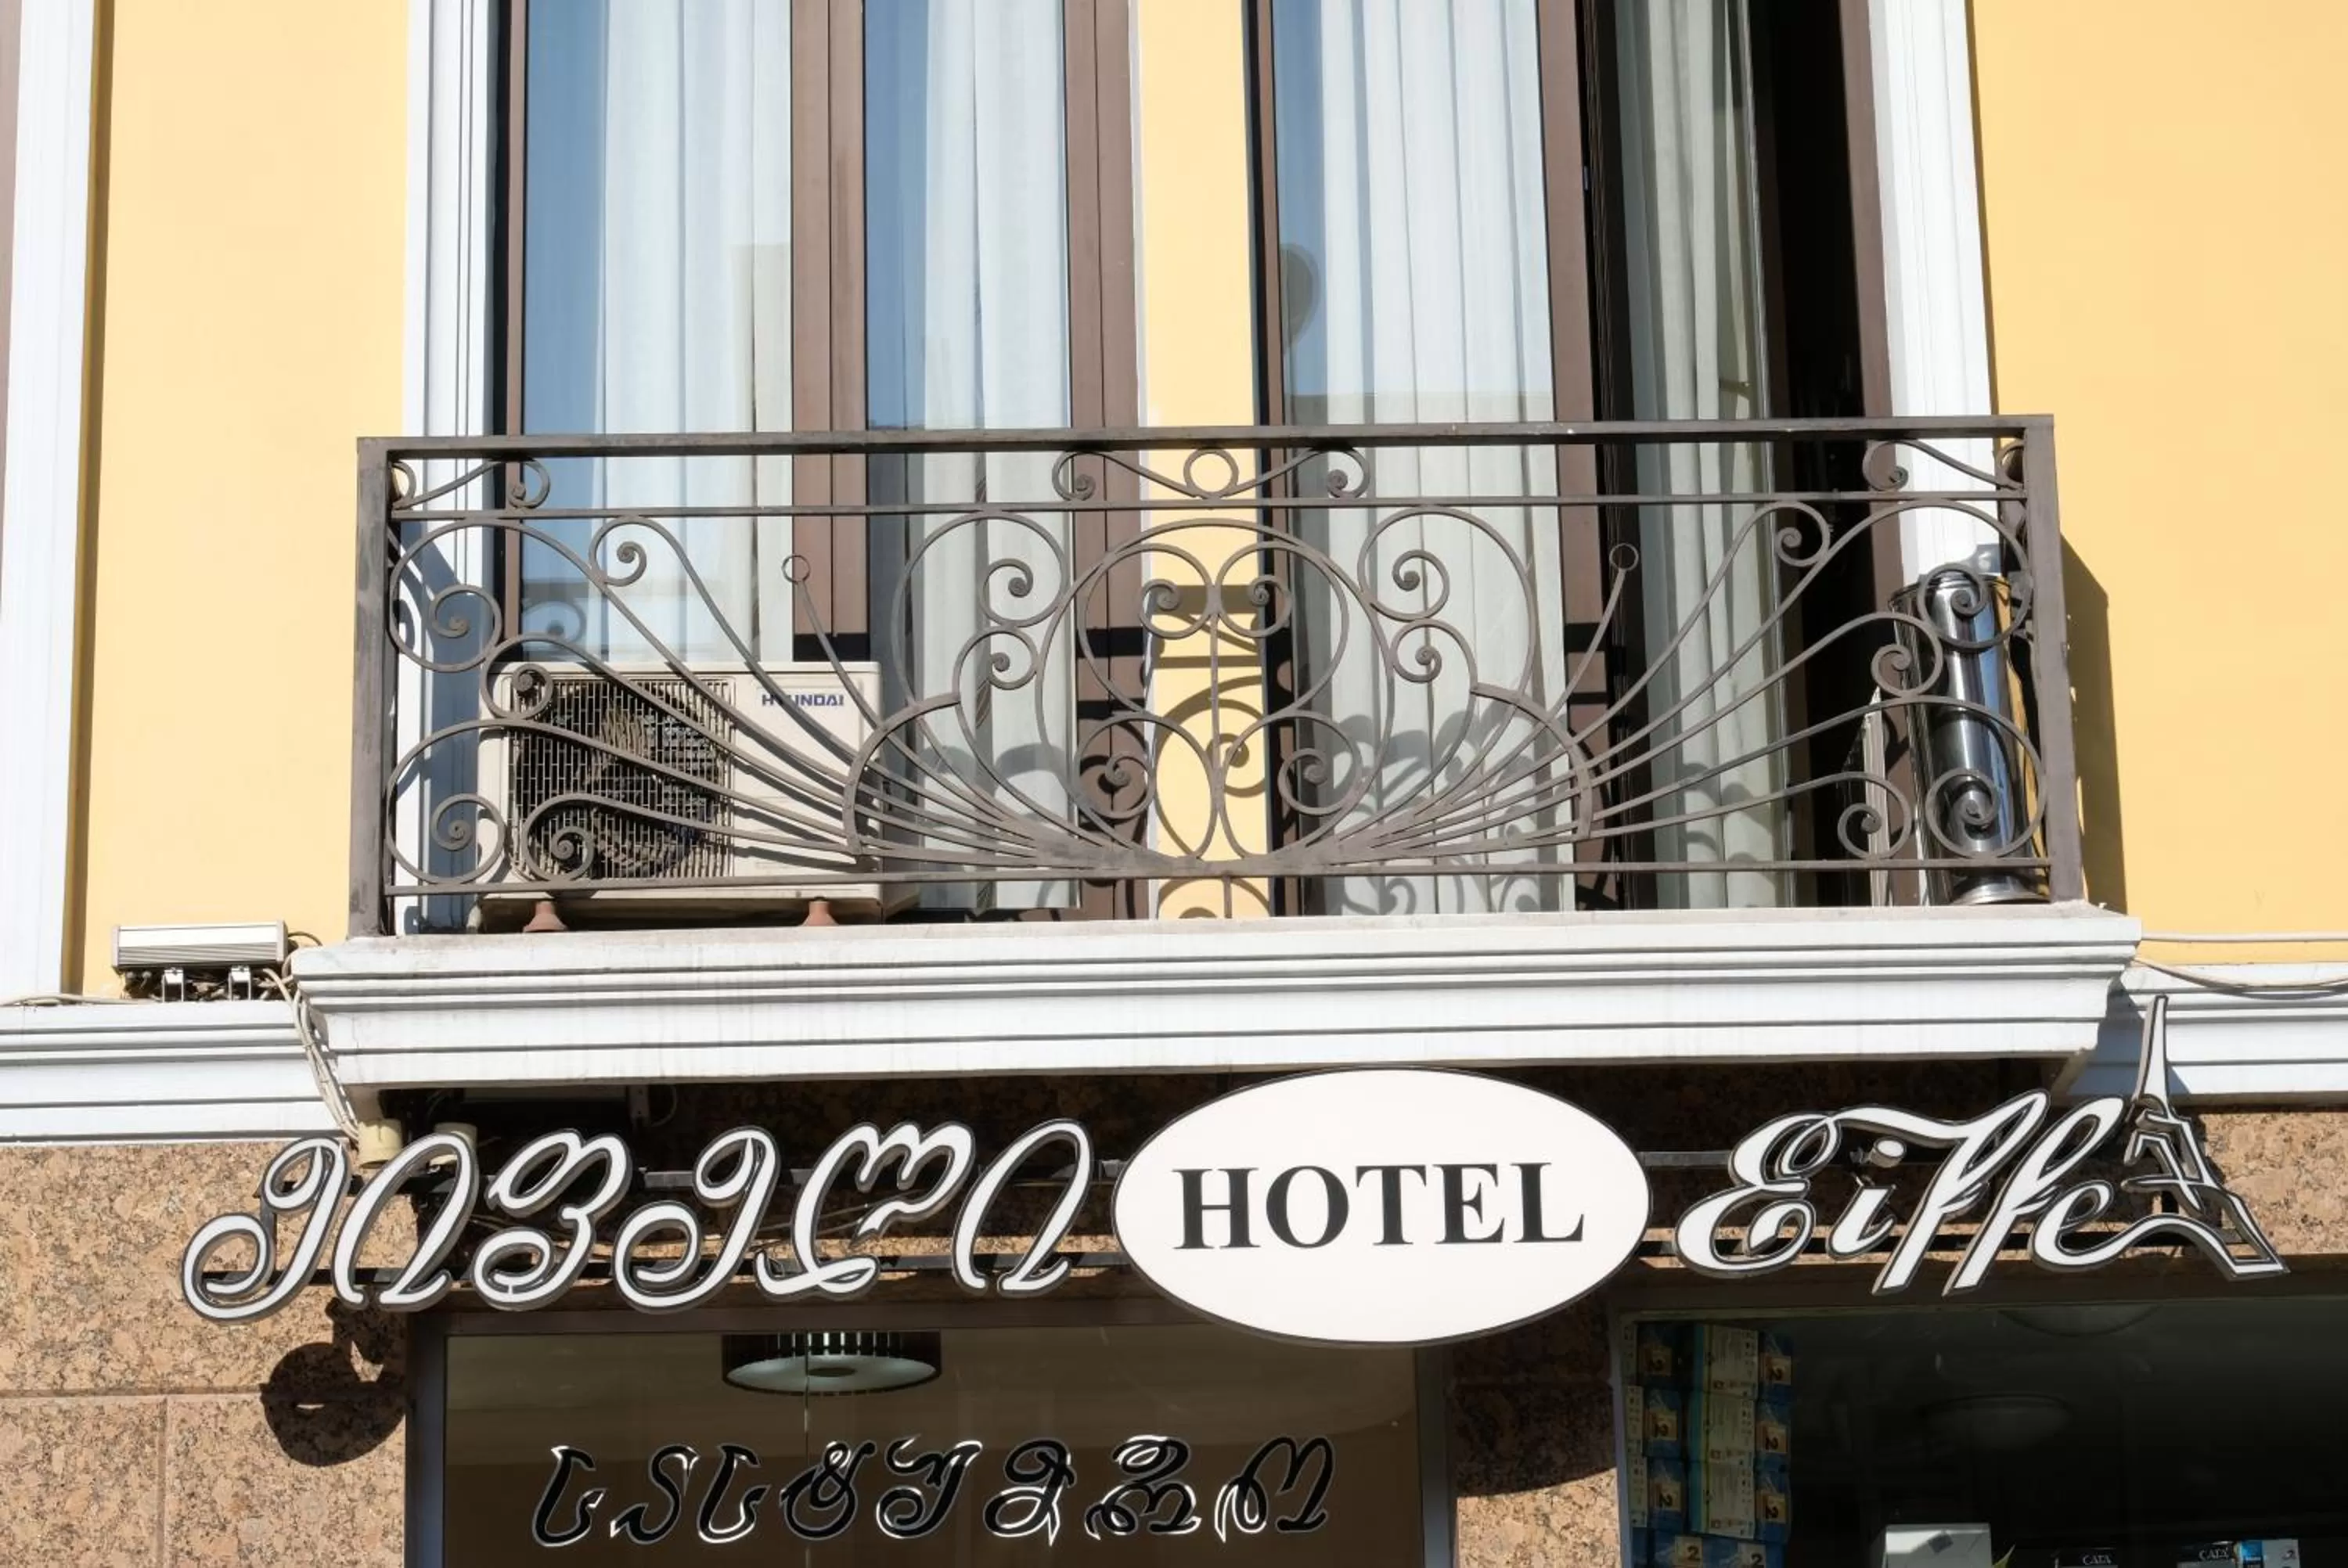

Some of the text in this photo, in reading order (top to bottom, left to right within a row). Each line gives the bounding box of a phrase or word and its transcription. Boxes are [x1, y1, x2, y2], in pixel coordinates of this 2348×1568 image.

[762, 694, 844, 706] HUNDAI
[182, 1120, 1094, 1322] ეიფელი
[1172, 1161, 1585, 1250] HOTEL
[530, 1433, 1337, 1548] სასტუმრო
[1687, 1545, 1700, 1561] 2
